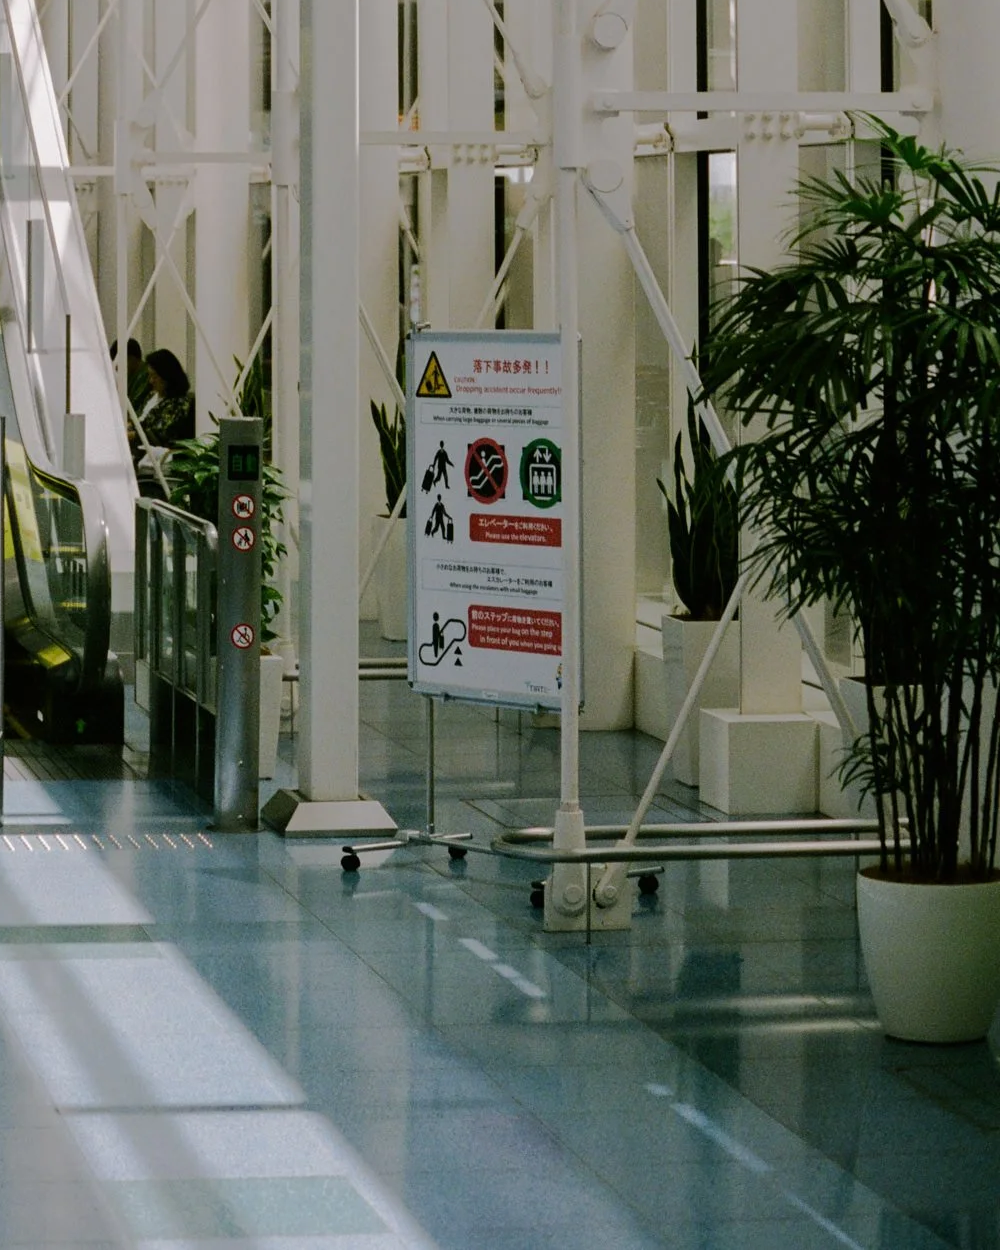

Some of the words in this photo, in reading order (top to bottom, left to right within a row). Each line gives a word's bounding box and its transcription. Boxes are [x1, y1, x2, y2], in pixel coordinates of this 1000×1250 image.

[456, 385, 483, 395] Dropping
[484, 385, 508, 393] accident
[509, 386, 526, 394] occur
[446, 416, 464, 424] carrying
[485, 531, 500, 539] Please
[512, 627, 520, 636] bag
[530, 628, 540, 637] the
[541, 630, 553, 640] step
[479, 635, 486, 643] in
[486, 635, 501, 645] front
[501, 637, 508, 645] of
[509, 639, 520, 647] you
[520, 640, 534, 648] when
[534, 642, 543, 650] you
